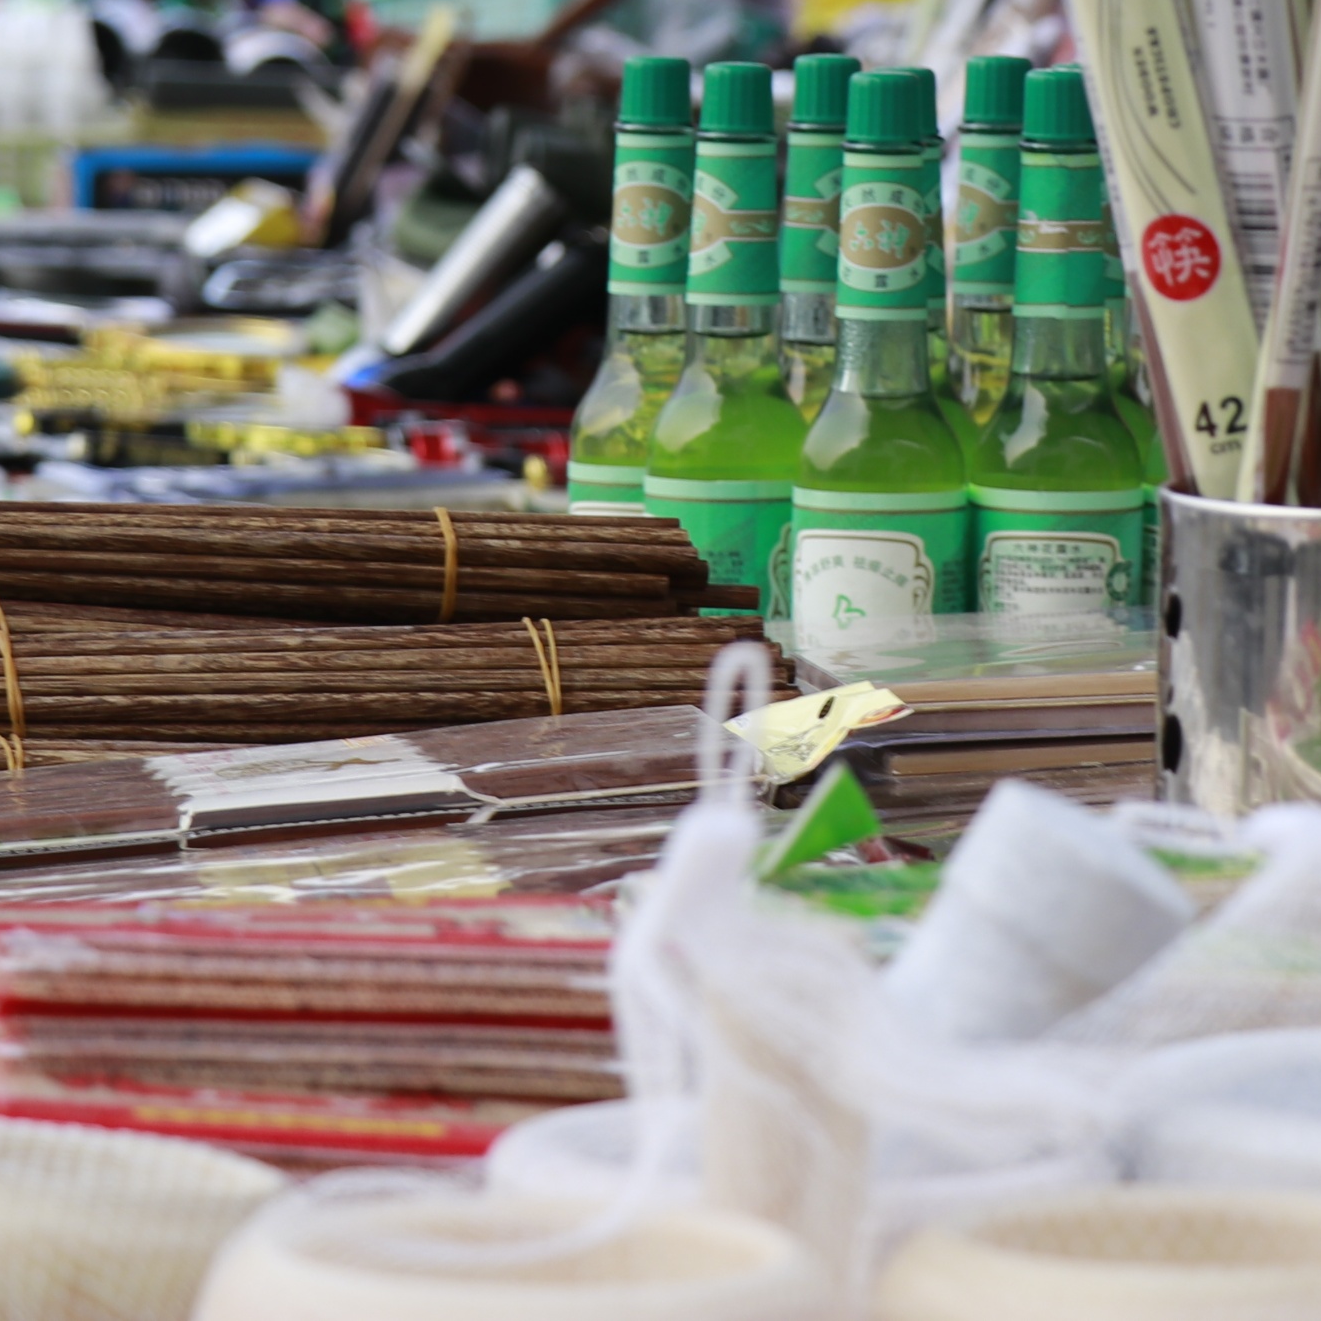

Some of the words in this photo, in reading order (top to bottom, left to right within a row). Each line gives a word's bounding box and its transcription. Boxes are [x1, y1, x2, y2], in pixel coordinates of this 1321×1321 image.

[1148, 227, 1211, 287] 筷
[1194, 396, 1248, 438] 42
[1210, 440, 1242, 455] cm
